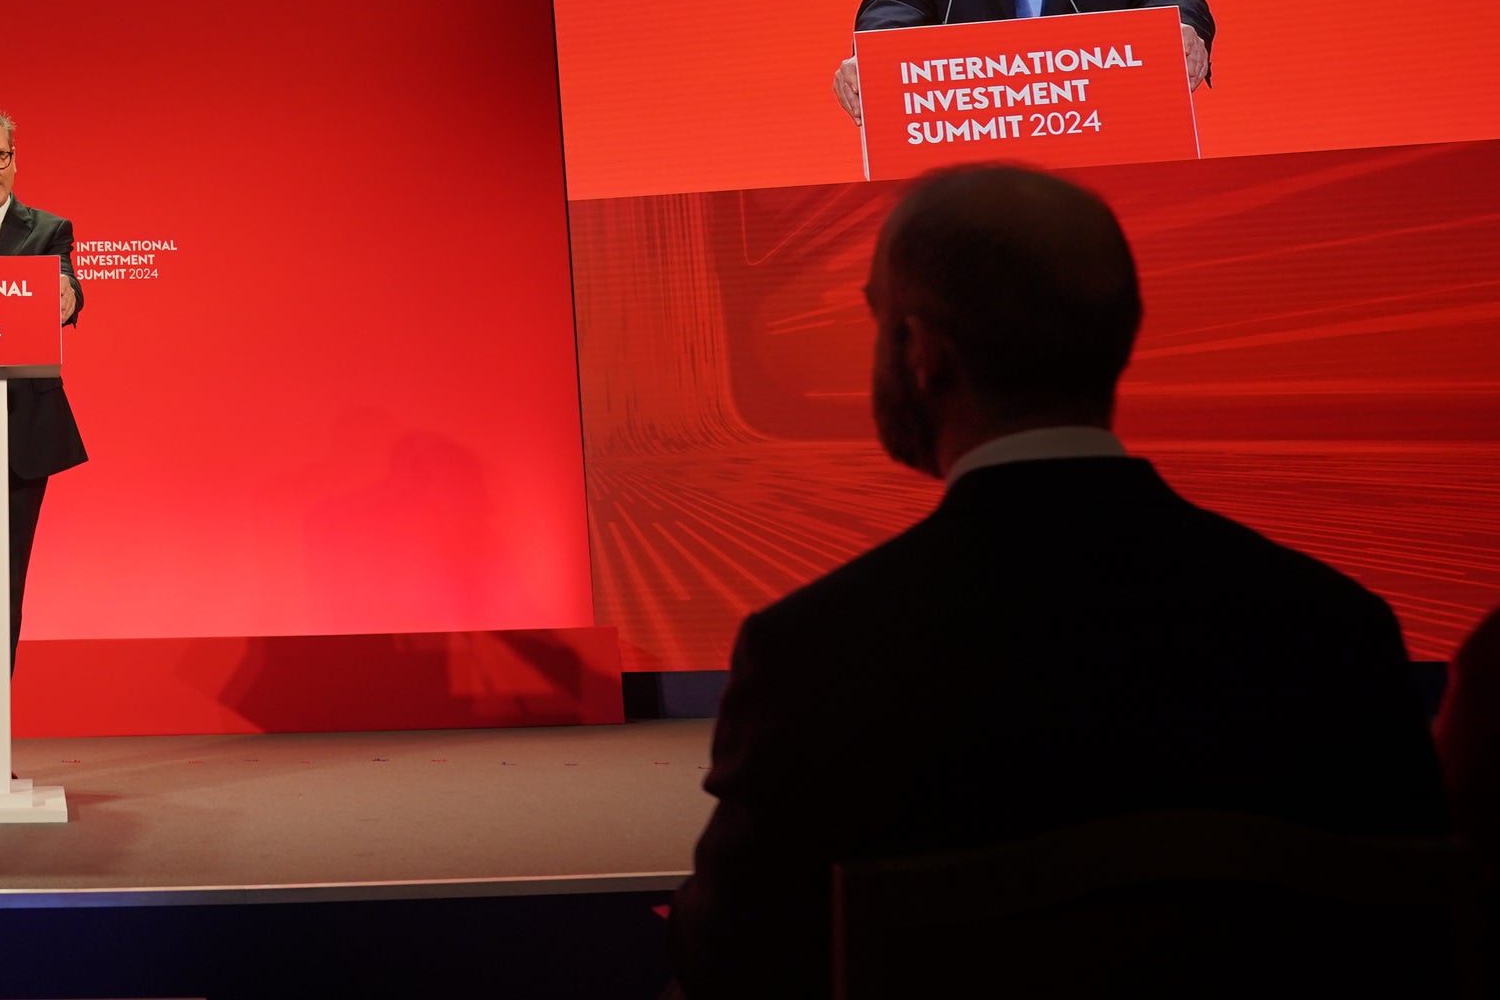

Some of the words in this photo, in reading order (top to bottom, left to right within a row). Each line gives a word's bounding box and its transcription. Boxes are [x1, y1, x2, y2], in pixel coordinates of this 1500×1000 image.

[900, 44, 1143, 84] INTERNATIONAL
[904, 80, 1089, 115] INVESTMENT
[907, 115, 1023, 145] SUMMIT
[1029, 109, 1102, 137] 2024
[76, 239, 178, 253] INTERNATIONAL
[76, 254, 156, 267] INVESTMENT
[76, 268, 127, 281] SUMMIT
[128, 267, 159, 280] 2024
